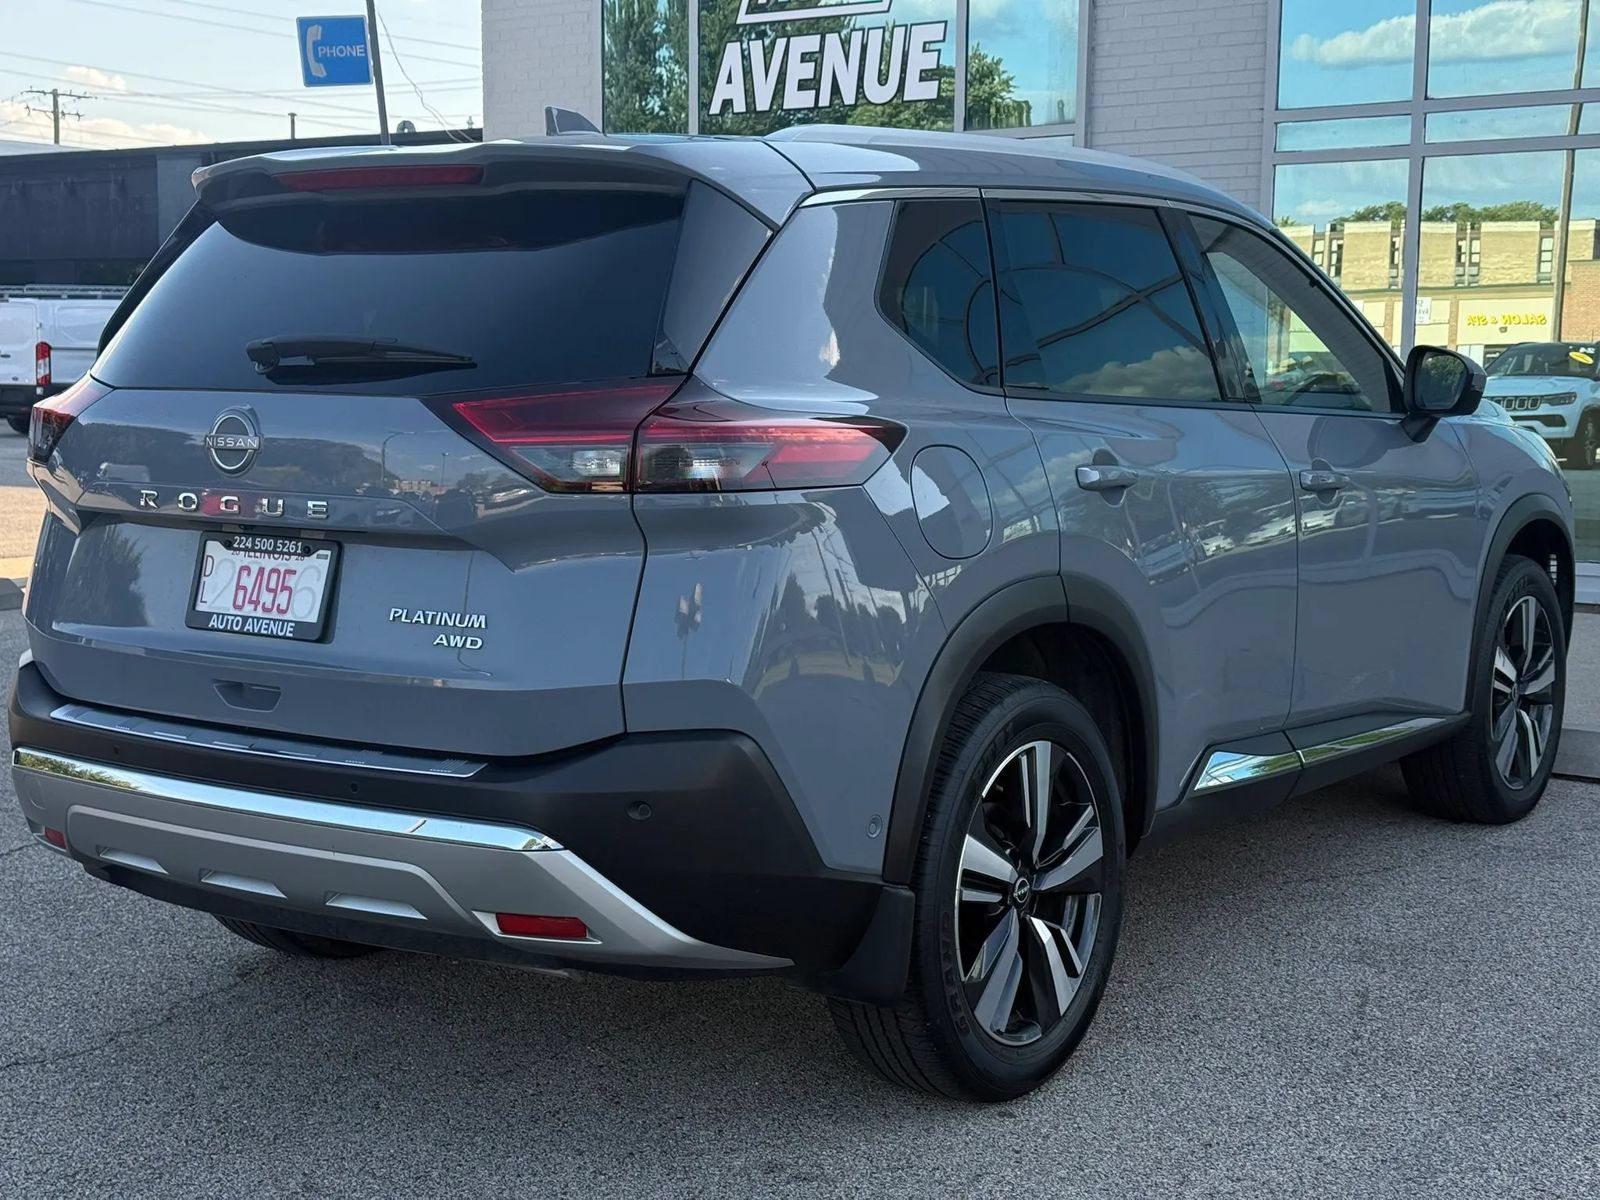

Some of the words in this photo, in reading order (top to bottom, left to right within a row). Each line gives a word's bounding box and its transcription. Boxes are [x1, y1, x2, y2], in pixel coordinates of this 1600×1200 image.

[317, 44, 366, 58] PHONE
[708, 20, 948, 115] AVENUE
[205, 436, 258, 449] NISSAN
[139, 489, 329, 519] ROGUE
[233, 536, 252, 549] 224
[254, 538, 275, 551] 500
[276, 540, 303, 554] 5261
[232, 564, 297, 615] 6495
[208, 614, 243, 631] AUTO
[243, 617, 296, 637] AVENUE
[389, 607, 487, 629] PLATINUM
[433, 633, 483, 650] AWD
